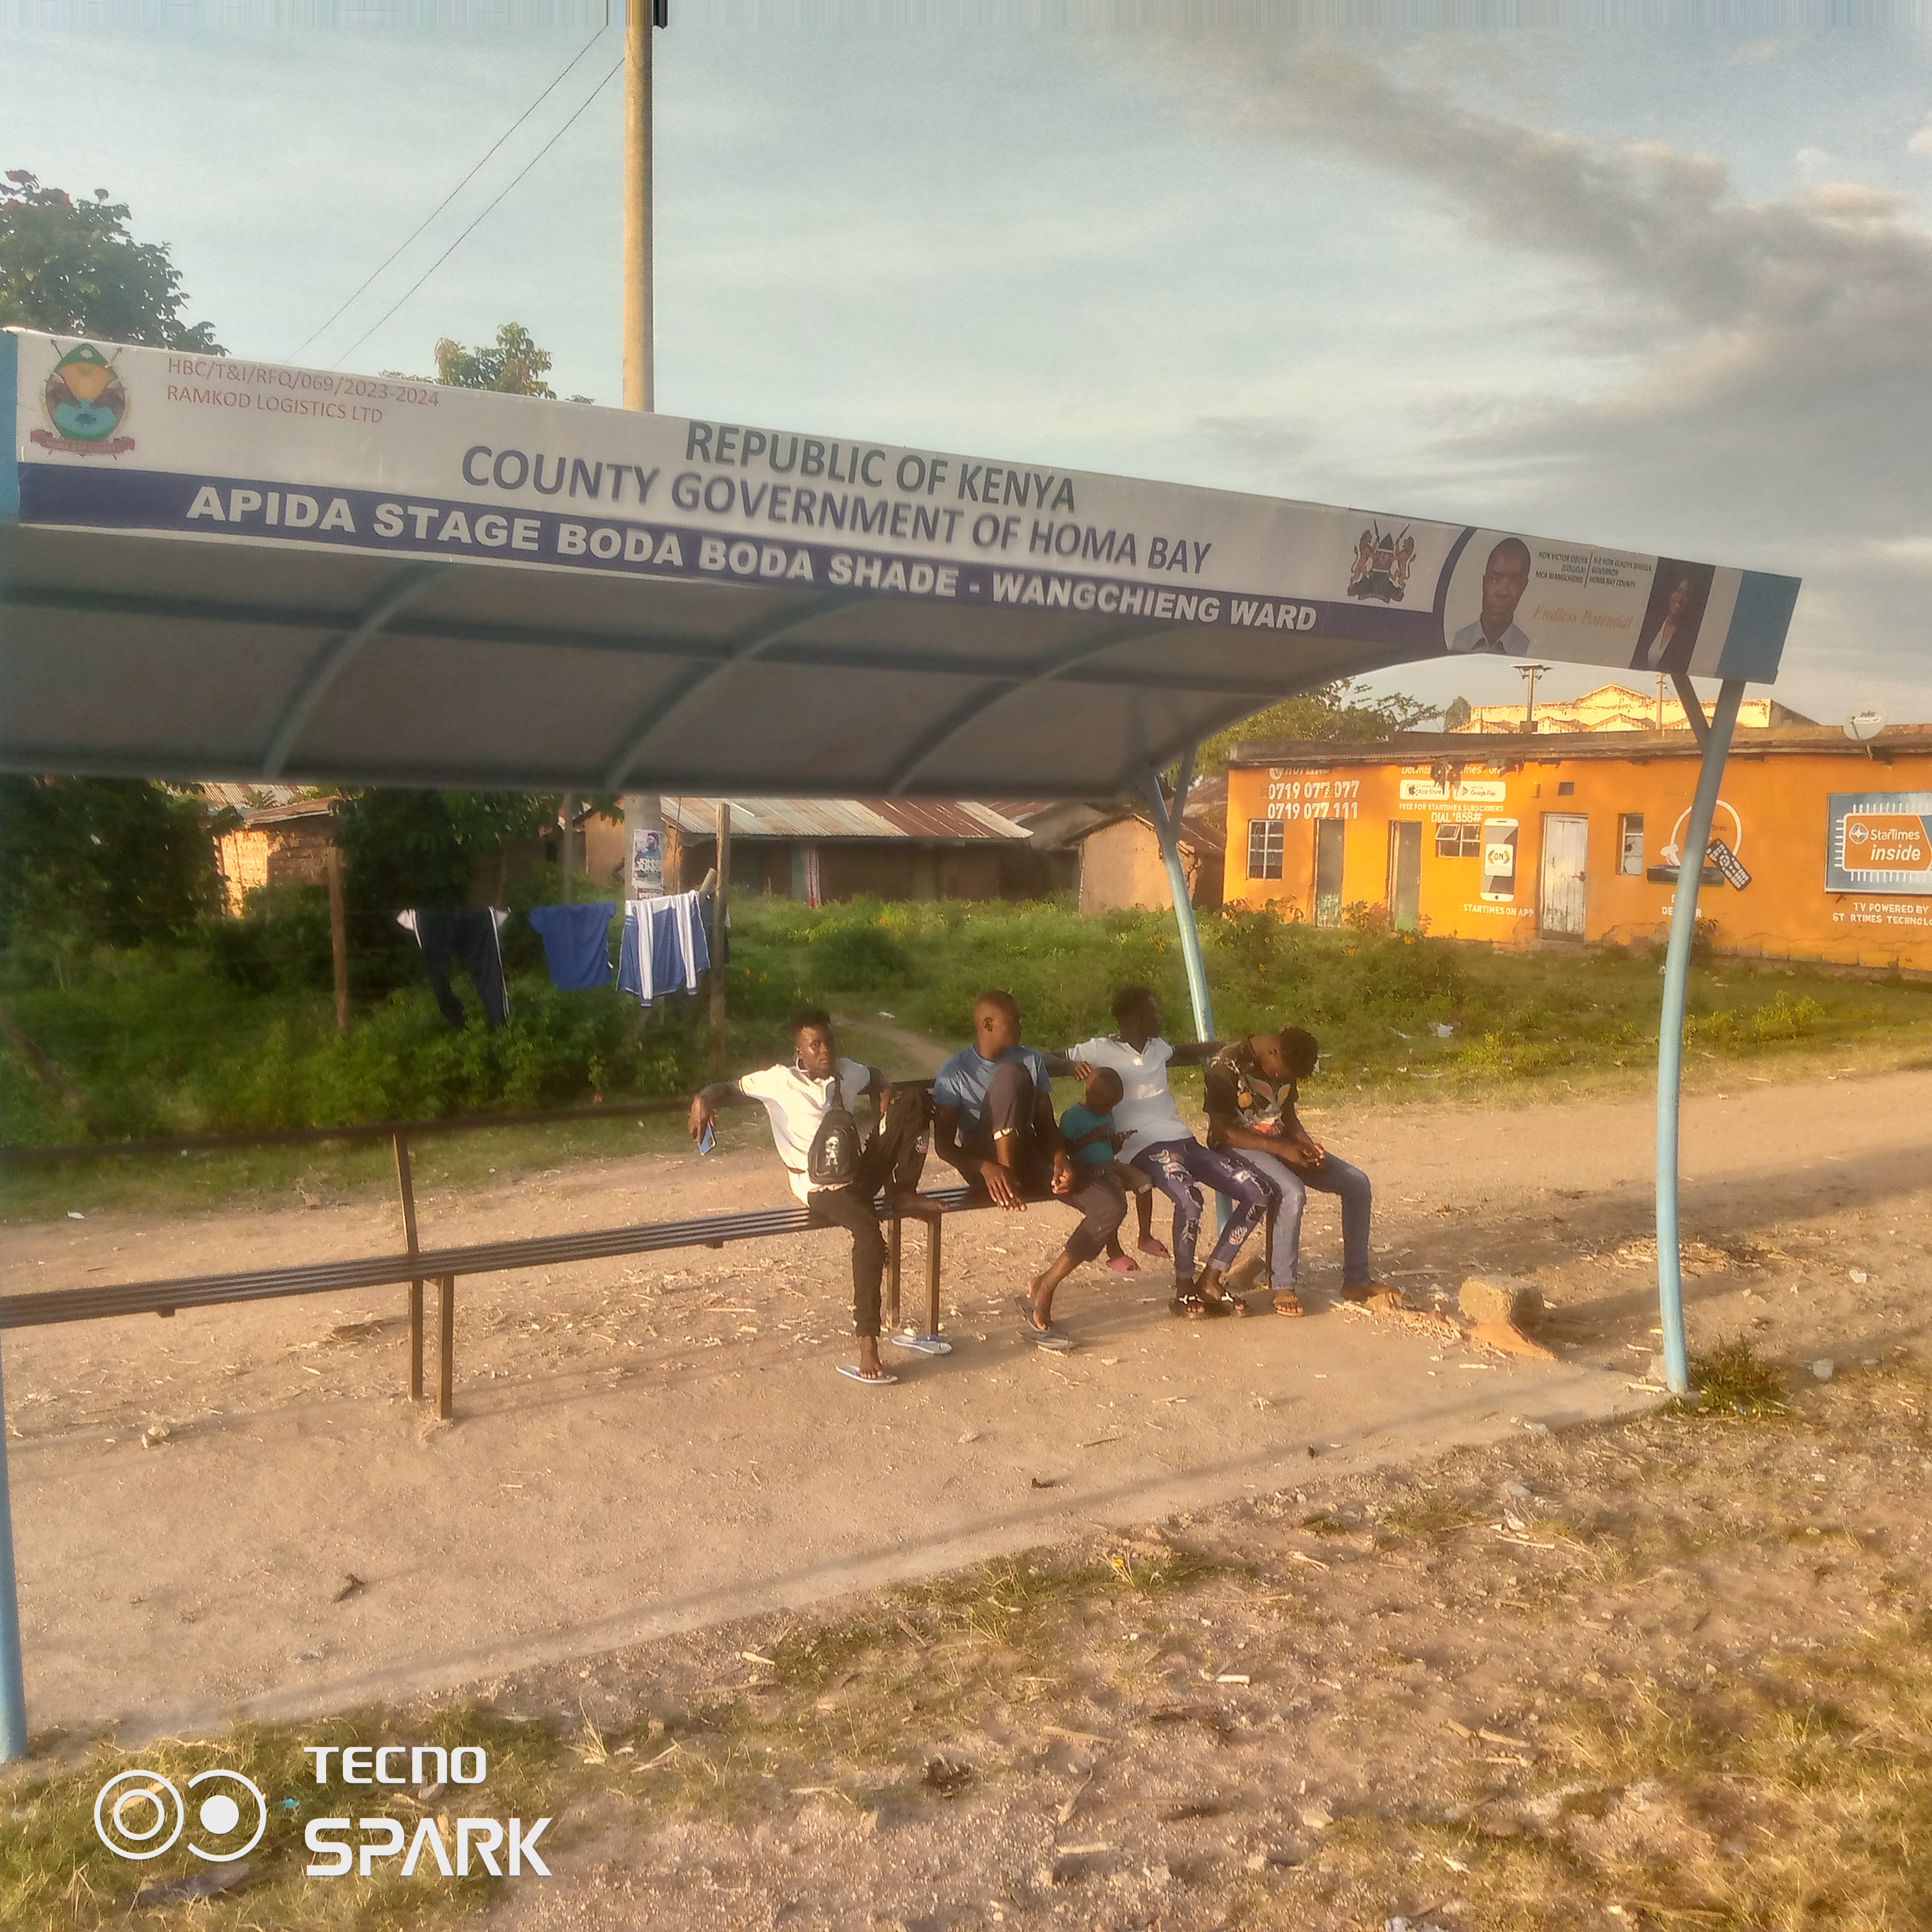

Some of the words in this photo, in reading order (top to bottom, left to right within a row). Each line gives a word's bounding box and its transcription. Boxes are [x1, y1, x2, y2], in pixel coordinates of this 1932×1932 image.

[169, 358, 439, 406] HBC/T&I/RFQ/069/2023-2024
[167, 385, 251, 408] RAMKOD
[257, 395, 346, 420] LOGISTICS
[352, 406, 383, 423] LTD
[686, 421, 885, 487] REPUBLIC
[896, 455, 948, 495] OF
[958, 463, 1074, 513] KENYA
[462, 445, 660, 504] COUNTY
[672, 472, 964, 544] GOVERNMENT
[972, 512, 1020, 550] OF
[1029, 518, 1137, 566] HOMA
[1148, 537, 1212, 574] BAY
[187, 485, 357, 534] APIDA
[373, 502, 541, 551] STAGE
[556, 522, 684, 567] BODA
[698, 537, 814, 582] BODA
[827, 552, 959, 598] SHADE
[969, 583, 980, 594] -
[992, 571, 1220, 623] WANGCHIENG
[1230, 599, 1317, 632] WARD
[1580, 610, 1634, 630] Potential
[1268, 781, 1301, 800] 0719
[1303, 781, 1331, 799] 077
[1333, 779, 1361, 799] 077
[1267, 802, 1301, 820] 0719
[1303, 801, 1330, 820] 077
[1333, 800, 1359, 820] 111
[1399, 802, 1414, 810] FREE
[1414, 803, 1426, 811] FOR
[1427, 803, 1461, 812] STARTIMES
[1431, 811, 1451, 823] DIAL
[1870, 828, 1921, 841] StarTimes
[1494, 853, 1504, 861] ON
[1870, 843, 1921, 862] inside
[1463, 903, 1505, 916] STARTIMES
[1506, 907, 1517, 917] ON
[1832, 912, 1883, 924] STRTIMES
[1853, 902, 1867, 912] TV
[1869, 903, 1915, 914] POWERED
[1915, 904, 1930, 915] BY
